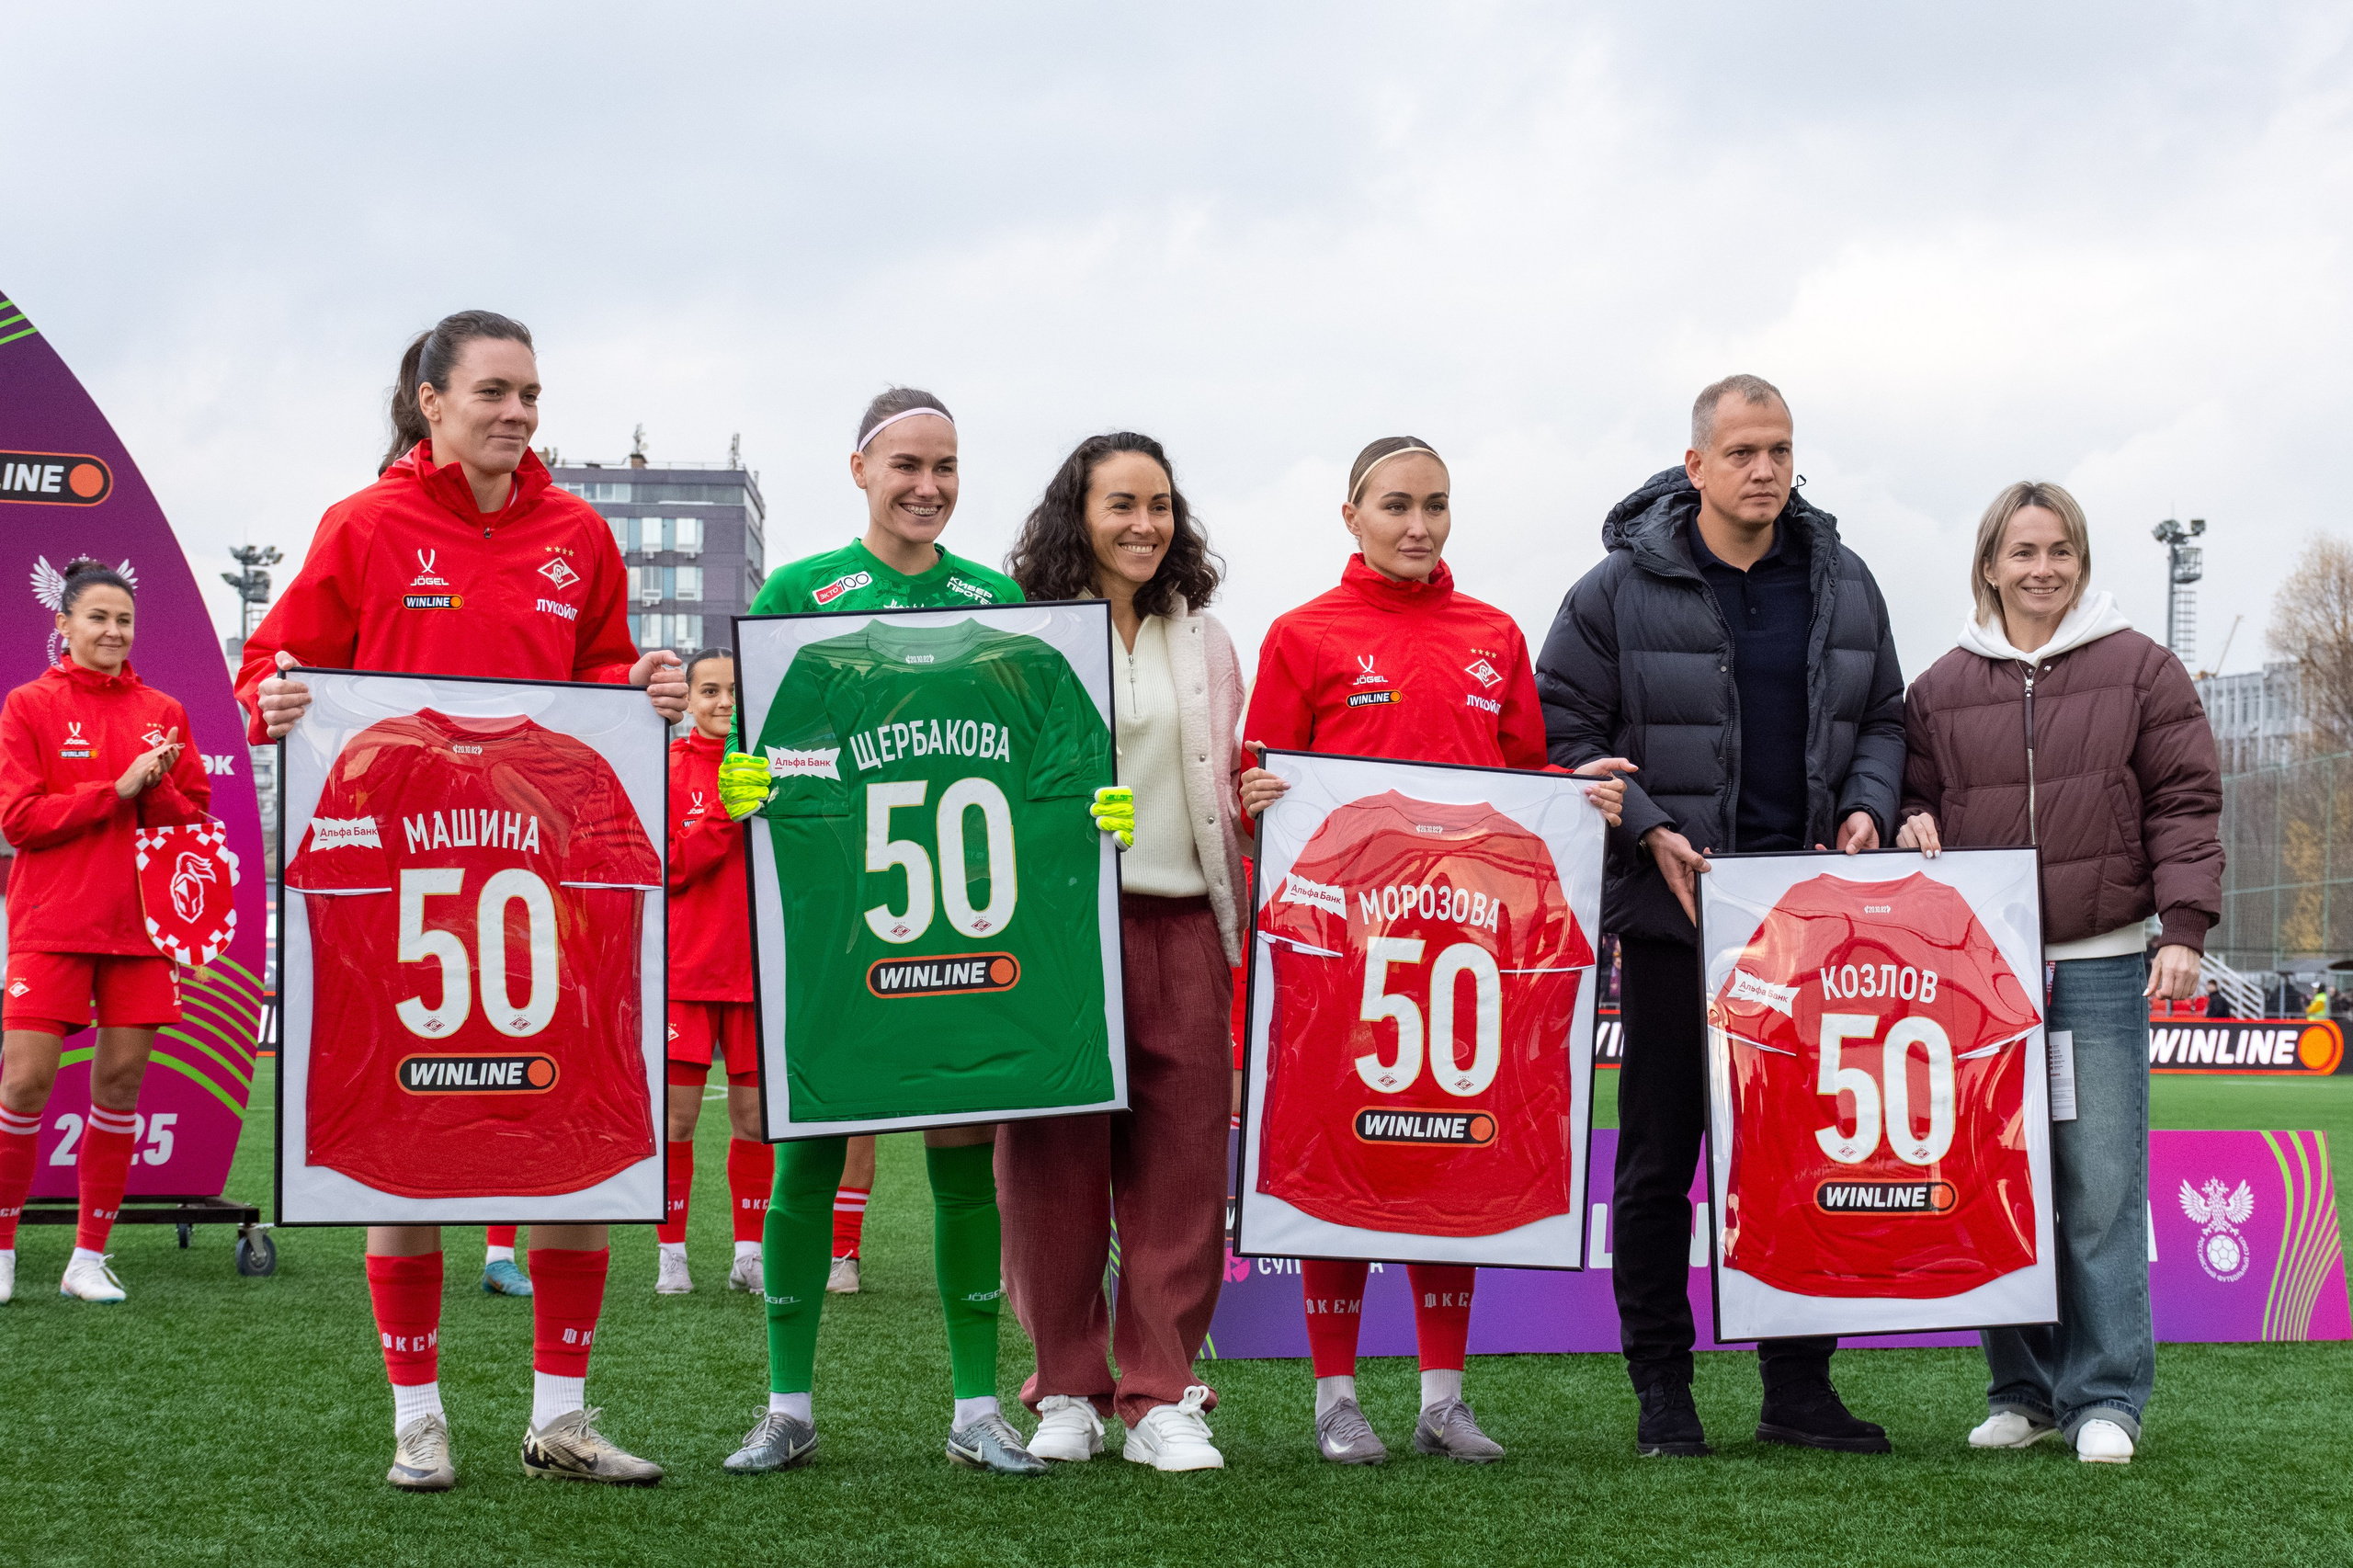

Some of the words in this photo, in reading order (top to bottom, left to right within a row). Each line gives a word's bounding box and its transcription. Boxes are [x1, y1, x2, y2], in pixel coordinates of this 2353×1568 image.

[0, 462, 64, 494] INE
[410, 575, 449, 586] JÖGEL
[820, 586, 839, 600] ЭКТО
[836, 573, 870, 593] 100
[949, 576, 994, 598] КИБЕР
[406, 597, 450, 608] WINLINE
[947, 582, 993, 605] ПРОТЕ
[536, 599, 578, 621] ЛУКОЙЛ
[1352, 675, 1389, 686] JÖGEL
[1349, 692, 1390, 706] WINLINE
[1467, 694, 1502, 715] ЛУКОЙЛ
[849, 719, 1010, 771] ЩЕРБАКОВА
[775, 757, 805, 769] Альфа
[808, 757, 831, 767] Банк
[320, 827, 352, 841] Альфа
[354, 826, 378, 836] Банк
[403, 809, 540, 855] МАШИНА
[864, 777, 1018, 944] 50
[1290, 884, 1319, 898] Альфа
[1320, 891, 1342, 904] Банк
[1358, 884, 1501, 934] МОРОЗОВА
[395, 868, 559, 1040] 50
[880, 961, 986, 990] WINLINE
[1820, 963, 1939, 1004] КОЗЛОВ
[1738, 981, 1767, 995] Альфа
[1768, 989, 1789, 1003] Банк
[1354, 936, 1503, 1097] 50
[2149, 1028, 2298, 1064] WINLINE
[410, 1062, 524, 1086] WINLINE
[1814, 1013, 1956, 1165] 50
[1365, 1114, 1467, 1139] WINLINE
[1826, 1186, 1927, 1209] WINLINE
